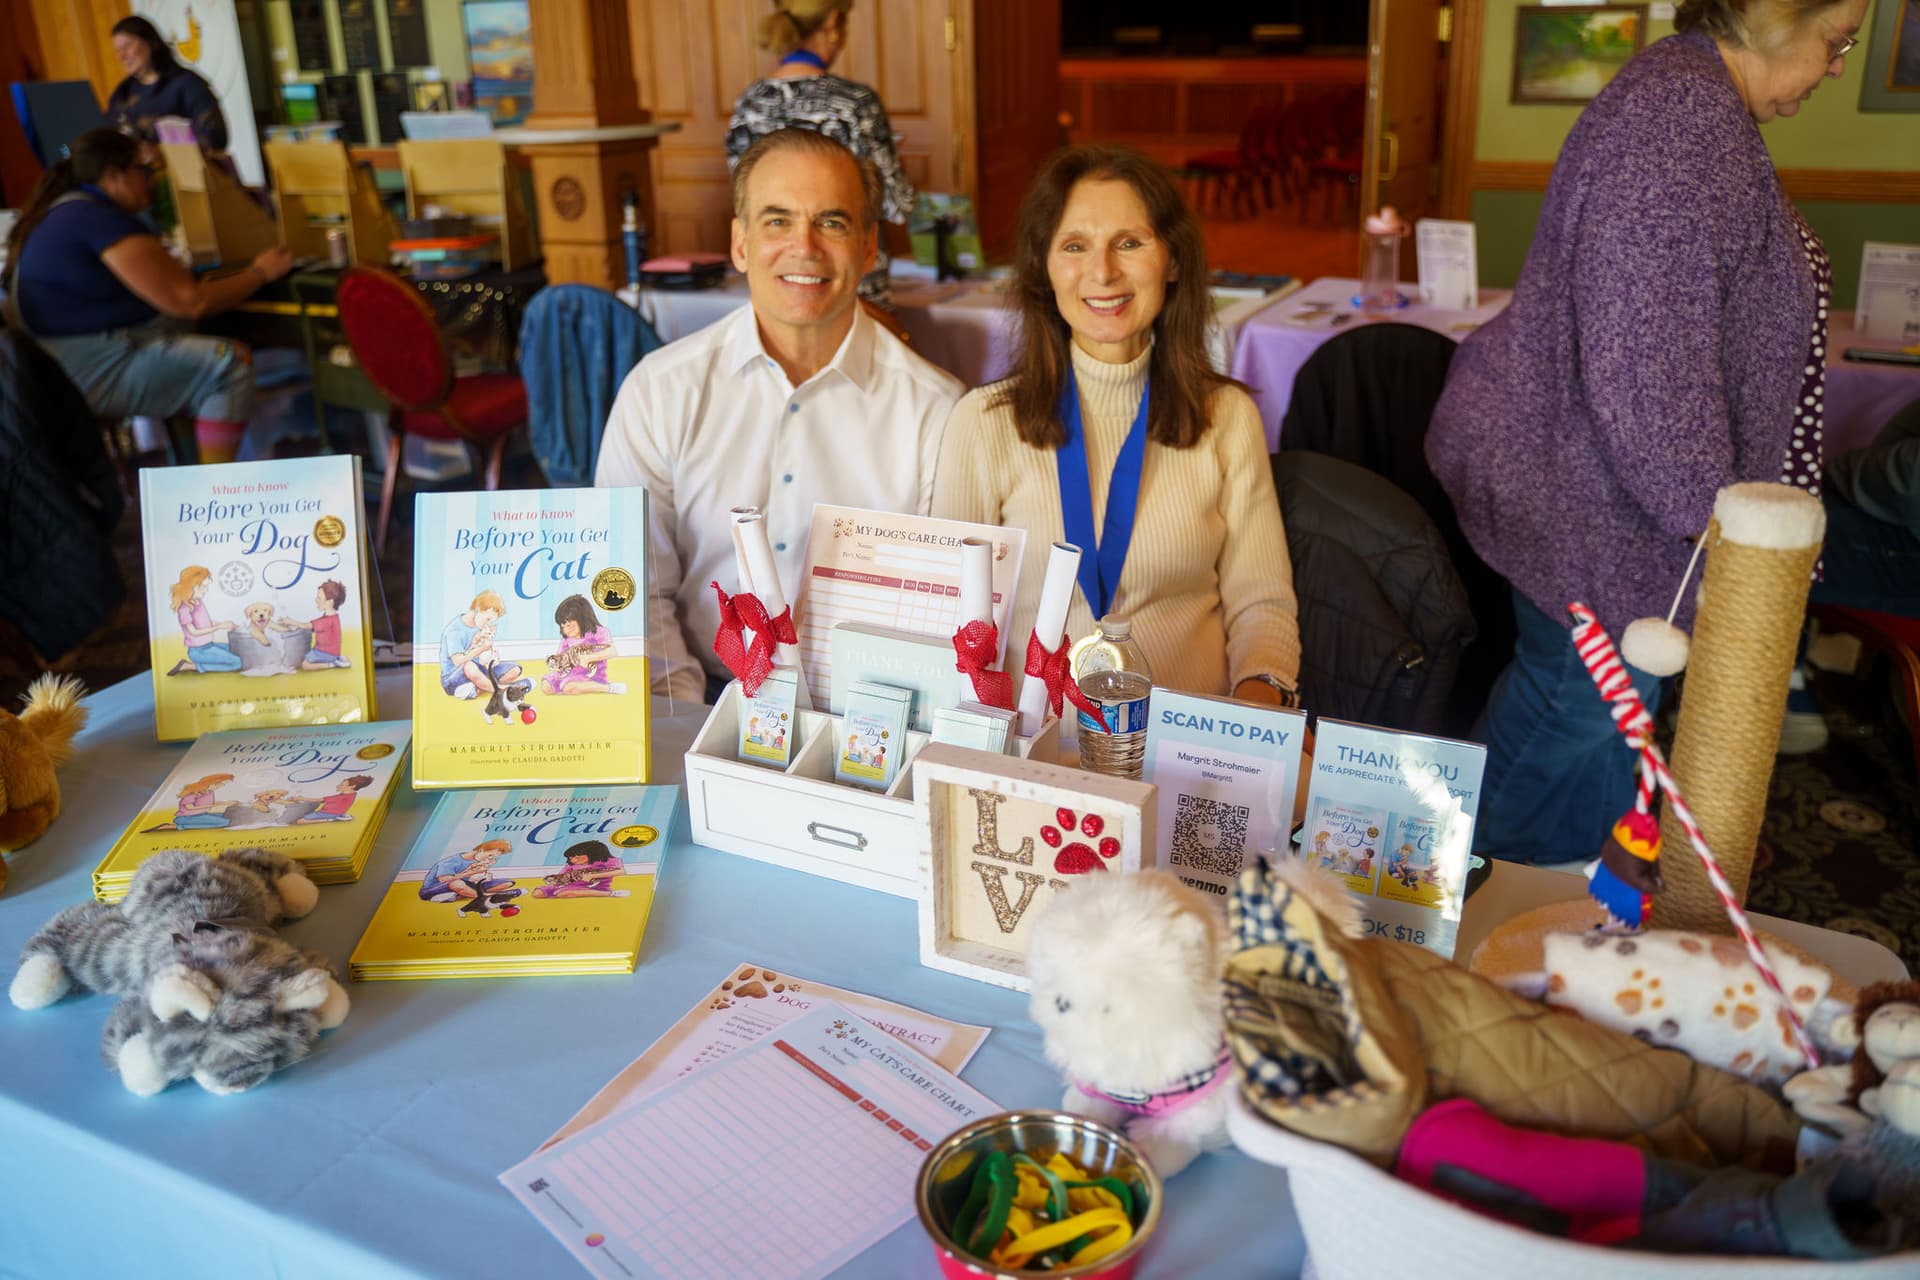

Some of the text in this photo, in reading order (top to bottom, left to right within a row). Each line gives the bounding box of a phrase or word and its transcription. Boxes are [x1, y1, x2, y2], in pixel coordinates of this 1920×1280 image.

[212, 481, 290, 495] What to Know
[178, 497, 323, 526] Before You Get
[492, 508, 575, 521] What to Know
[455, 526, 609, 552] Before You Get
[854, 525, 964, 548] MY DOG'S CARE CHA
[192, 530, 234, 545] Your
[239, 518, 341, 590] Dog
[470, 560, 514, 577] Your
[513, 547, 593, 600] Cat
[1161, 709, 1215, 733] SCAN
[1218, 719, 1245, 738] TO
[1249, 725, 1290, 746] PAY
[224, 737, 377, 755] Before You Get
[450, 742, 613, 754] MARGRIT STROHMAIER
[229, 748, 378, 784] Your Dog
[512, 756, 548, 764] CLAUDIA
[550, 755, 585, 763] GADOTTI
[1177, 752, 1262, 776] Margrit Strohmaier
[1413, 758, 1459, 781] YOU
[1318, 763, 1335, 774] WE
[1335, 766, 1396, 785] APPRECIATE
[1447, 786, 1474, 799] PORT
[473, 805, 639, 820] Before You Get
[520, 797, 555, 805] What
[570, 796, 607, 804] Know
[483, 822, 532, 834] Your
[526, 815, 617, 845] Cat
[968, 788, 1034, 866] L
[971, 861, 1068, 934] V
[408, 926, 601, 937] MARGRIT STROHMAIER
[1362, 918, 1426, 945] OK $18
[776, 995, 941, 1045] DOG ONTRACT
[850, 1035, 872, 1049] MY
[900, 1064, 932, 1091] CARE
[930, 1087, 976, 1120] CHART
